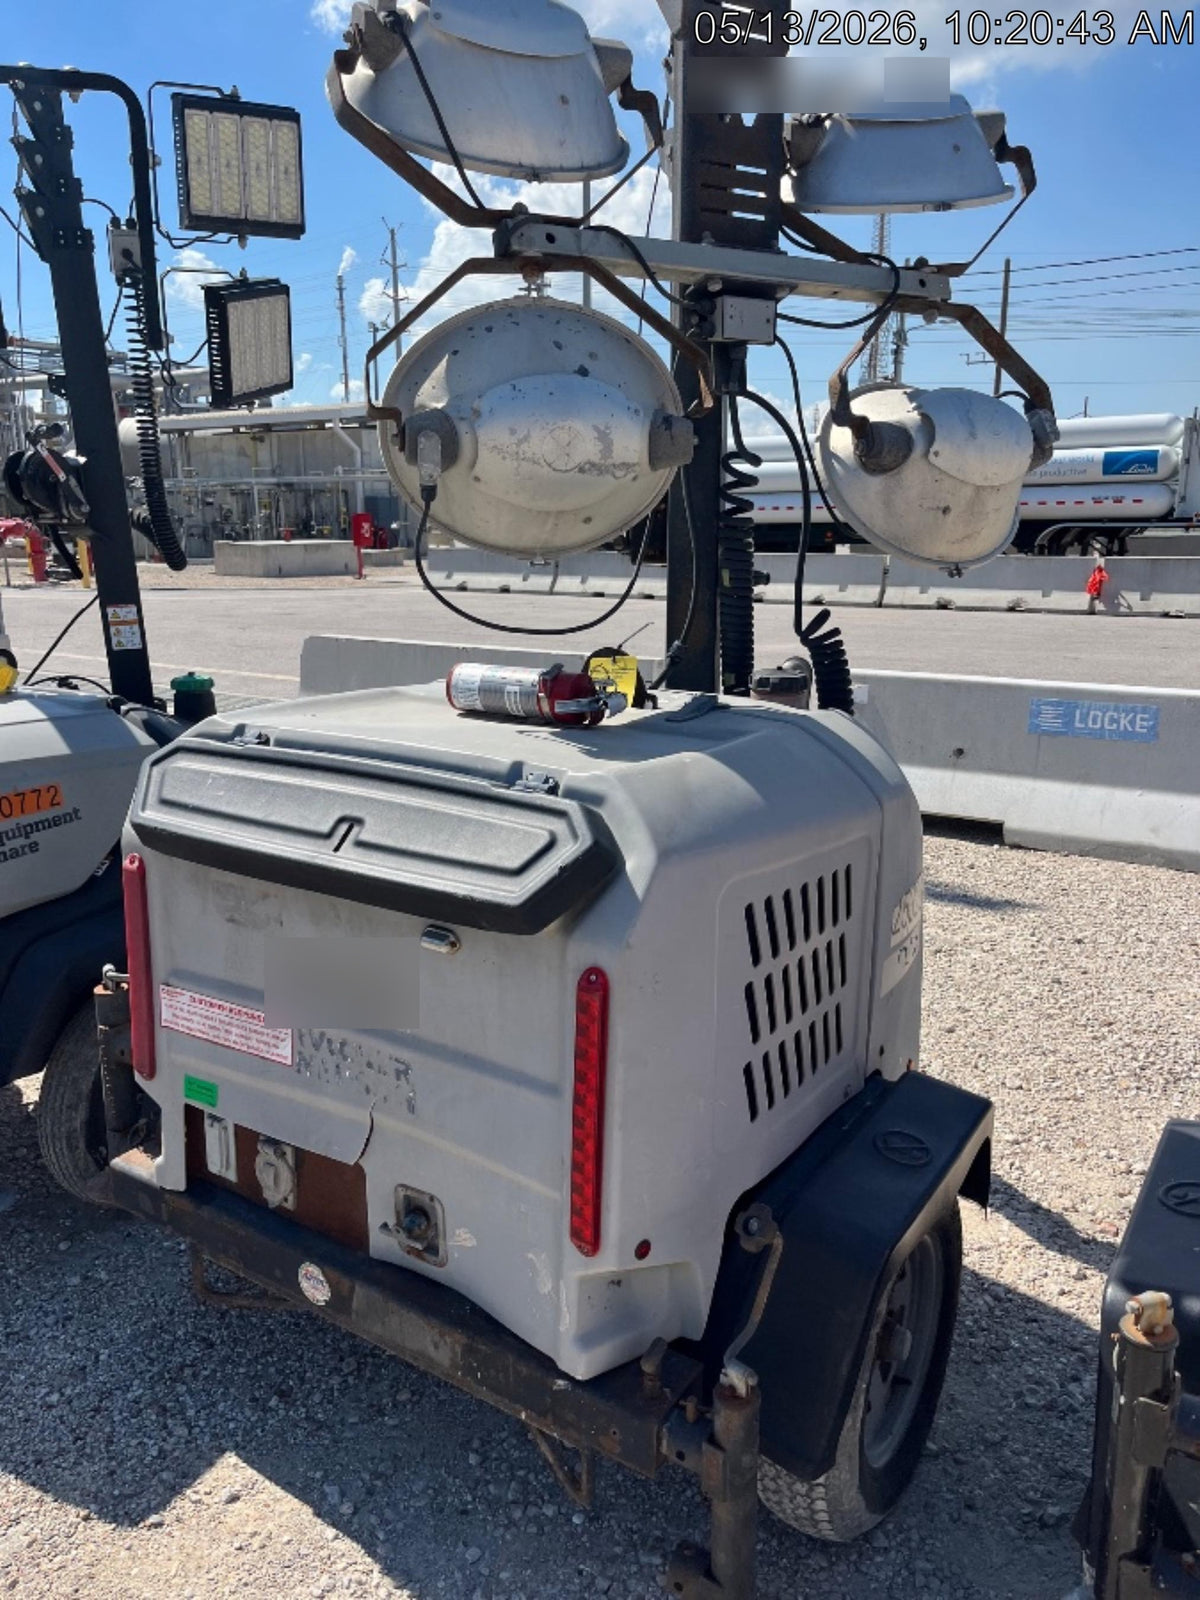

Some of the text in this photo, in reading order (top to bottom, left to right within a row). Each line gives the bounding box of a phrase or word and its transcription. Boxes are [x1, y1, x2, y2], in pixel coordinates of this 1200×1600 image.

[1040, 467, 1087, 479] productive
[1074, 709, 1151, 733] LOCKE
[0, 785, 60, 818] 0772
